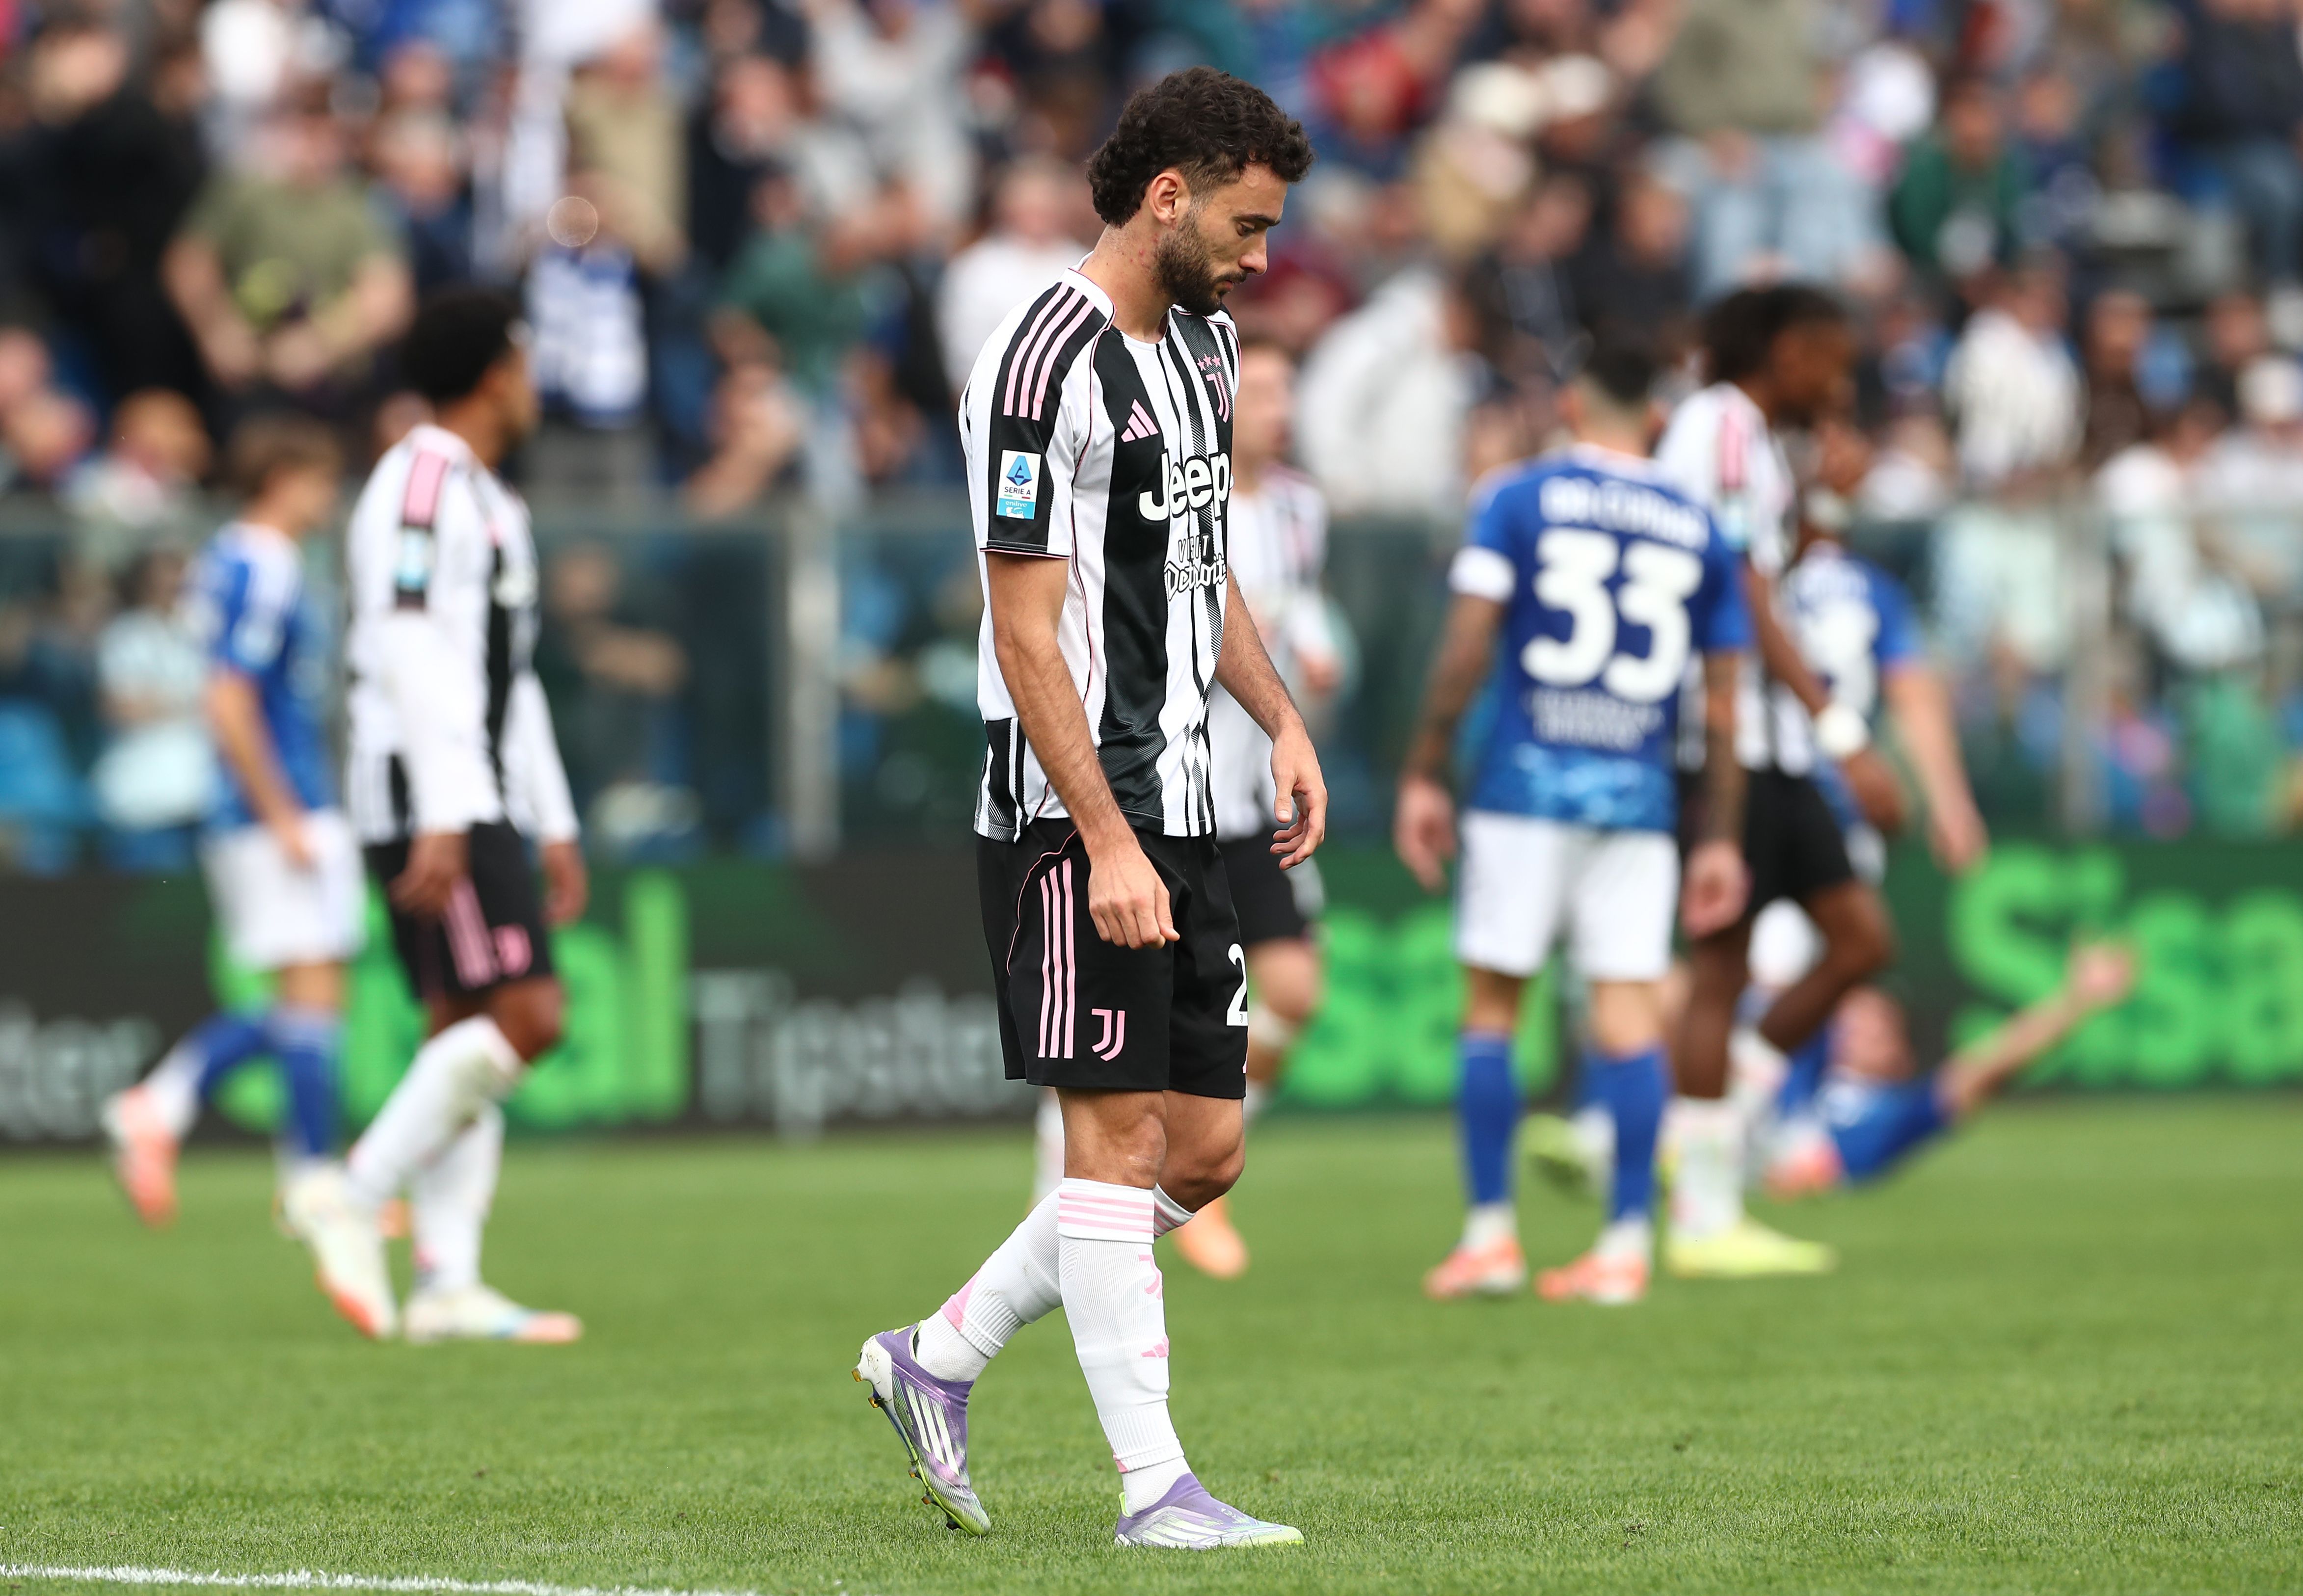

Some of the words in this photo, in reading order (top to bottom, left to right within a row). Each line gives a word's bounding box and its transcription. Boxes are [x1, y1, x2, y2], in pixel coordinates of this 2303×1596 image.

[1004, 486, 1024, 495] SERIE
[1138, 452, 1230, 521] Jeep
[1178, 533, 1210, 563] VISIT
[1164, 553, 1227, 602] Detroit
[1521, 524, 1704, 705] 33
